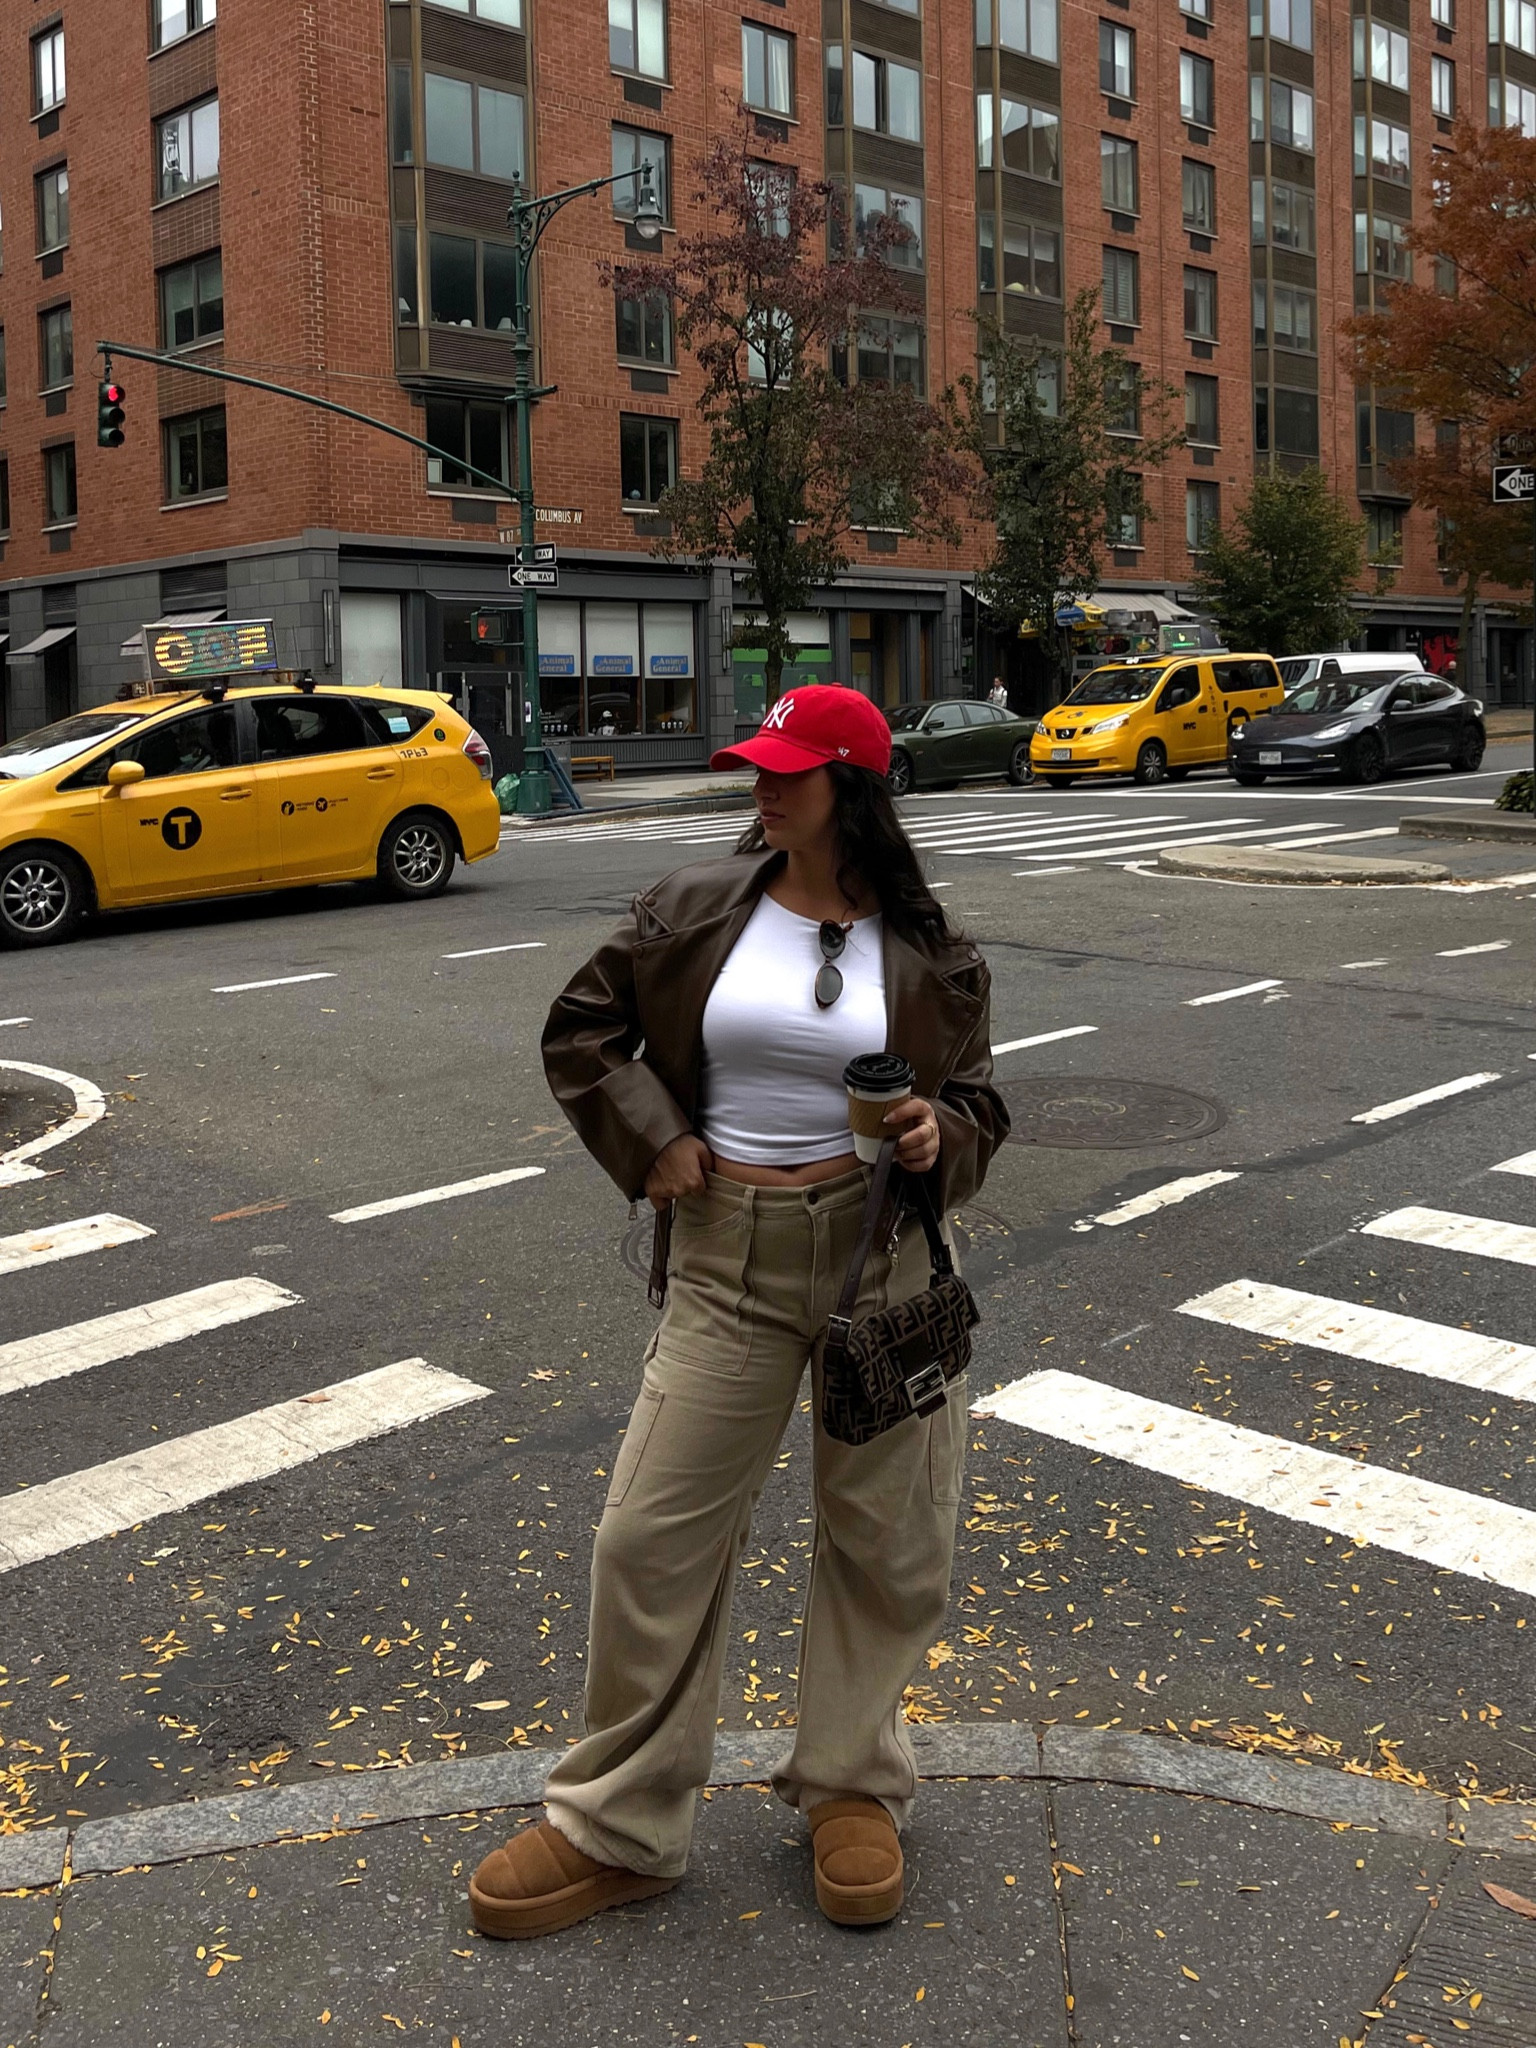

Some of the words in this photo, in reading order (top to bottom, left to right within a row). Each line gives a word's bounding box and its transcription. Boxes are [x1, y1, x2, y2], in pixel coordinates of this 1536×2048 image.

[1509, 476, 1534, 490] ONE
[535, 509, 572, 523] COLUMBUS
[537, 549, 550, 558] WAY
[762, 697, 794, 729] NY
[171, 816, 192, 844] T
